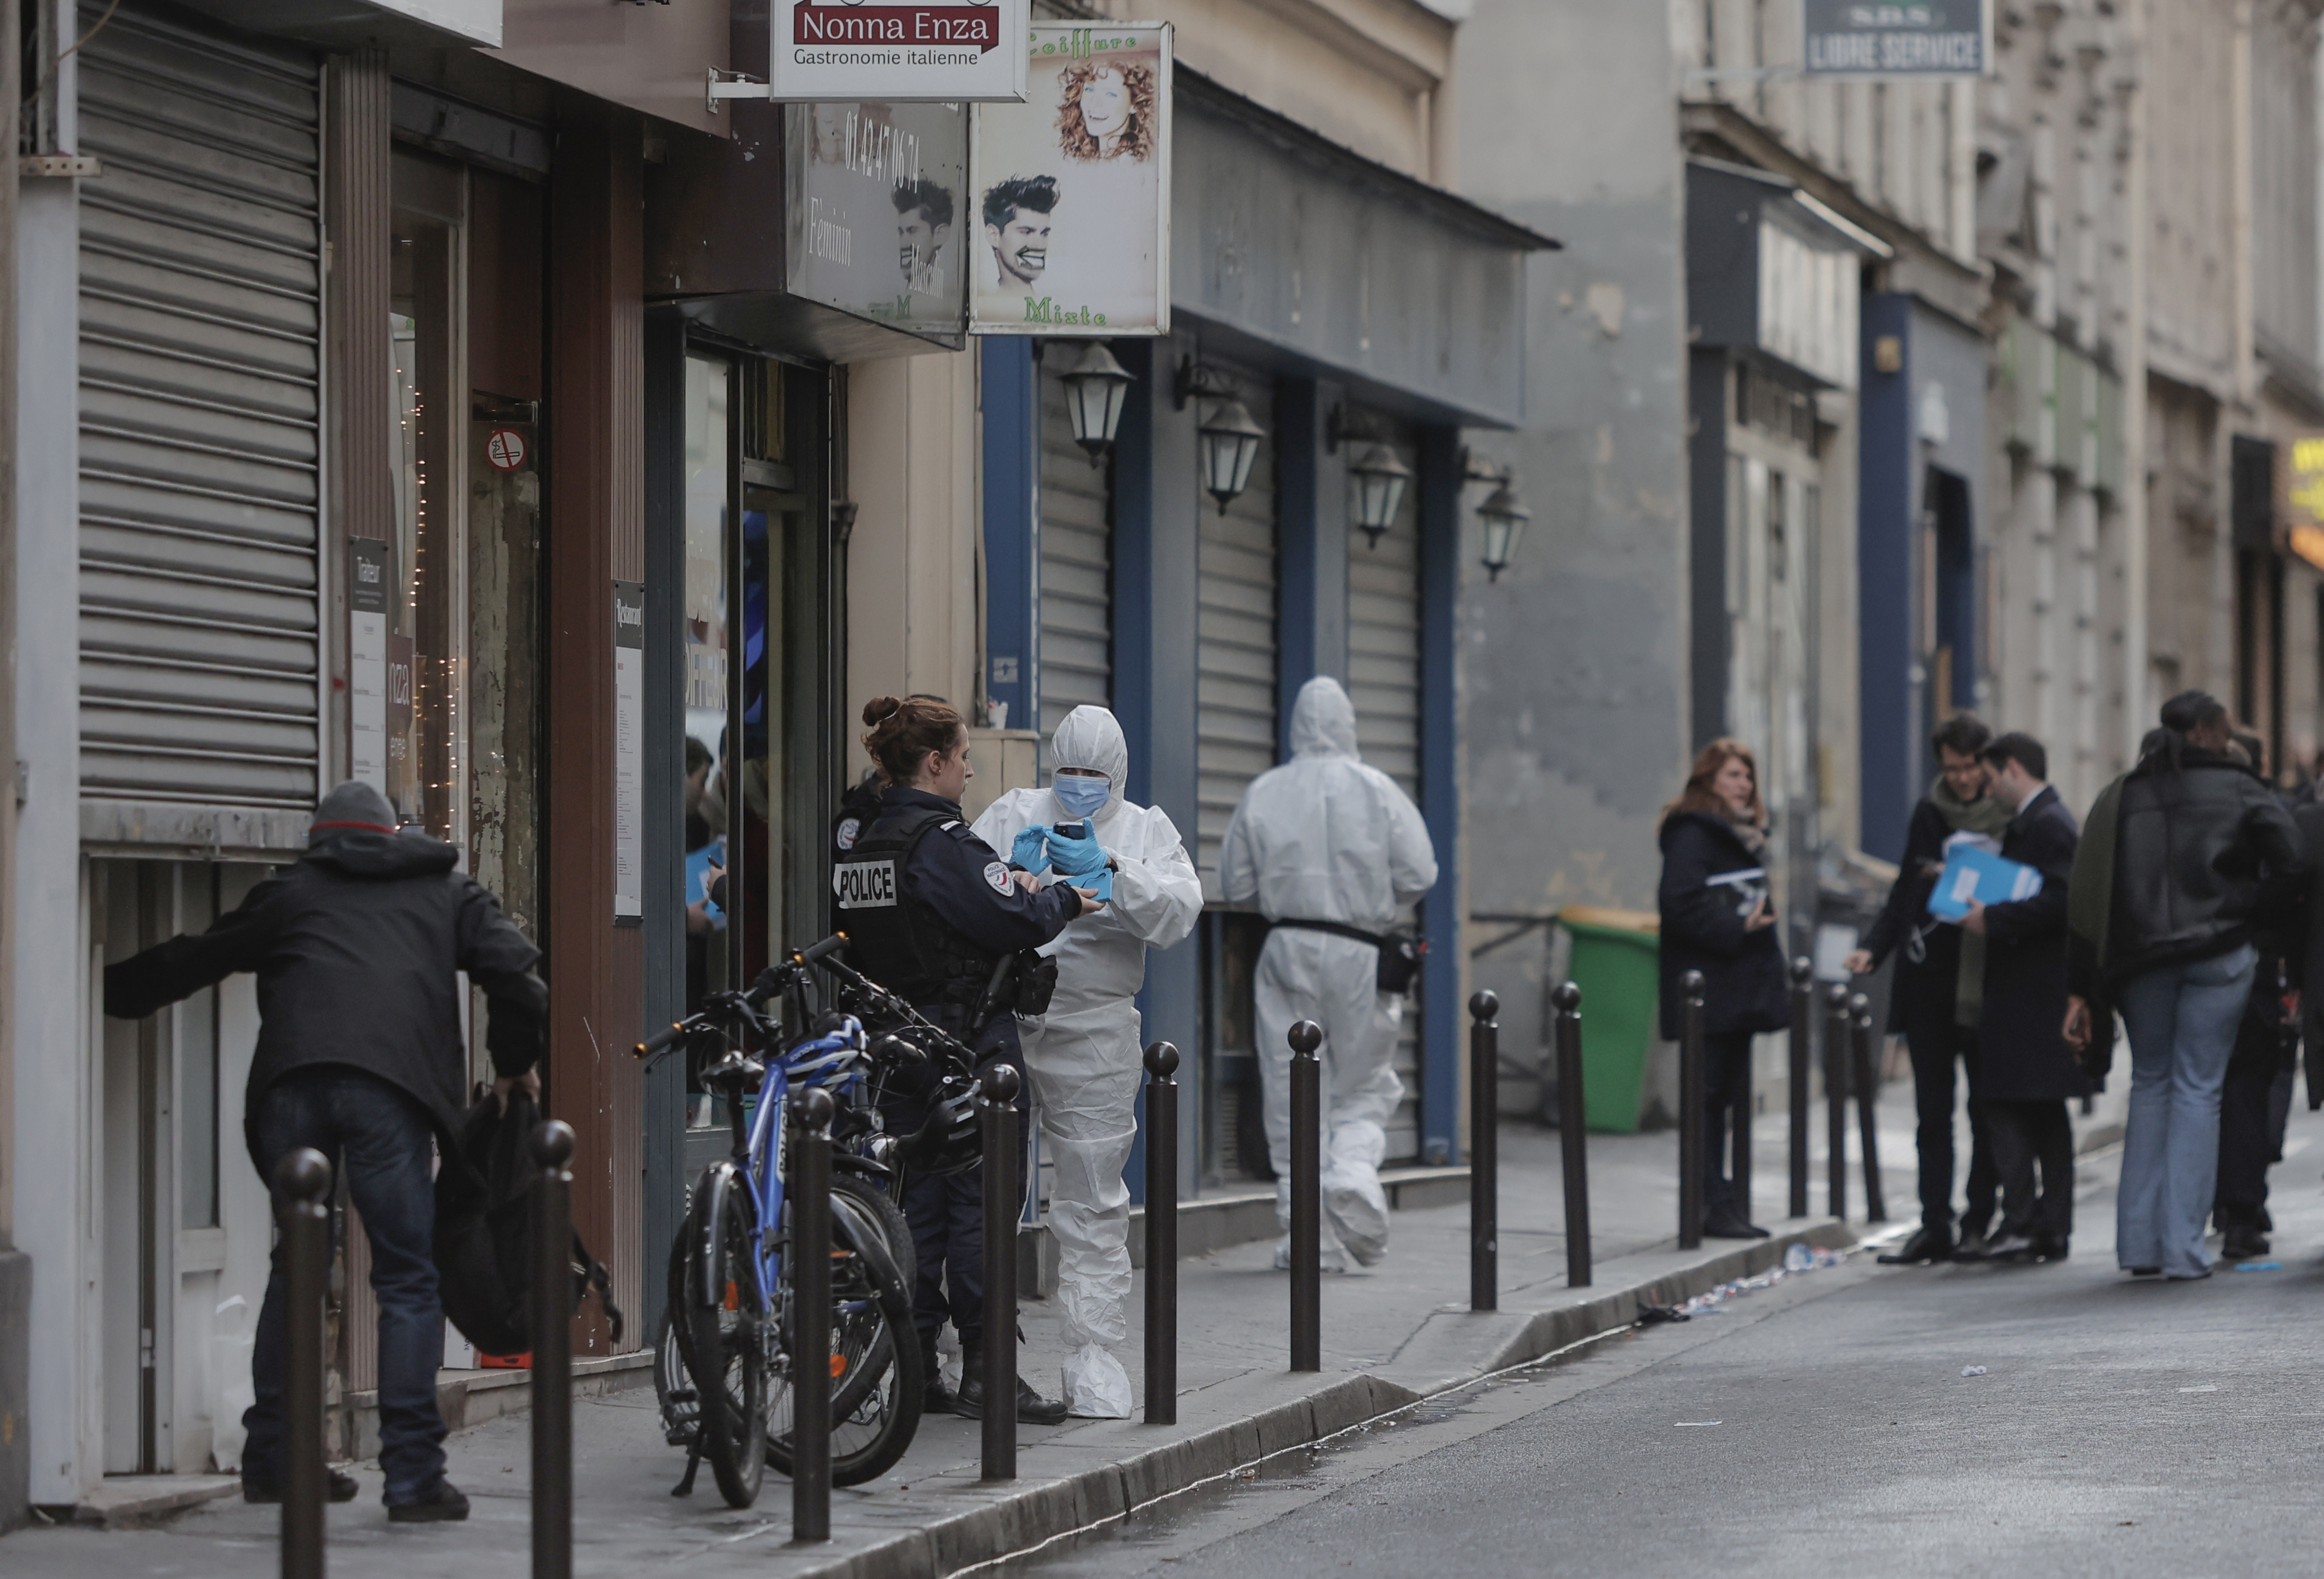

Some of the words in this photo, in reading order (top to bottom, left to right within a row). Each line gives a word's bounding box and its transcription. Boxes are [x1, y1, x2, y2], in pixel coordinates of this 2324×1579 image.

[804, 12, 905, 39] Nonna
[915, 13, 990, 40] Enza
[794, 49, 900, 65] Gastronomie
[907, 50, 978, 65] italienne
[1880, 33, 1981, 70] SERVICE
[845, 111, 858, 171] 01
[860, 117, 874, 178] 42
[876, 123, 890, 182] 47
[892, 128, 905, 188] 06
[908, 134, 920, 194] 74
[1024, 296, 1106, 326] Mixte
[616, 598, 642, 628] Restaurant
[840, 868, 894, 902] POLICE
